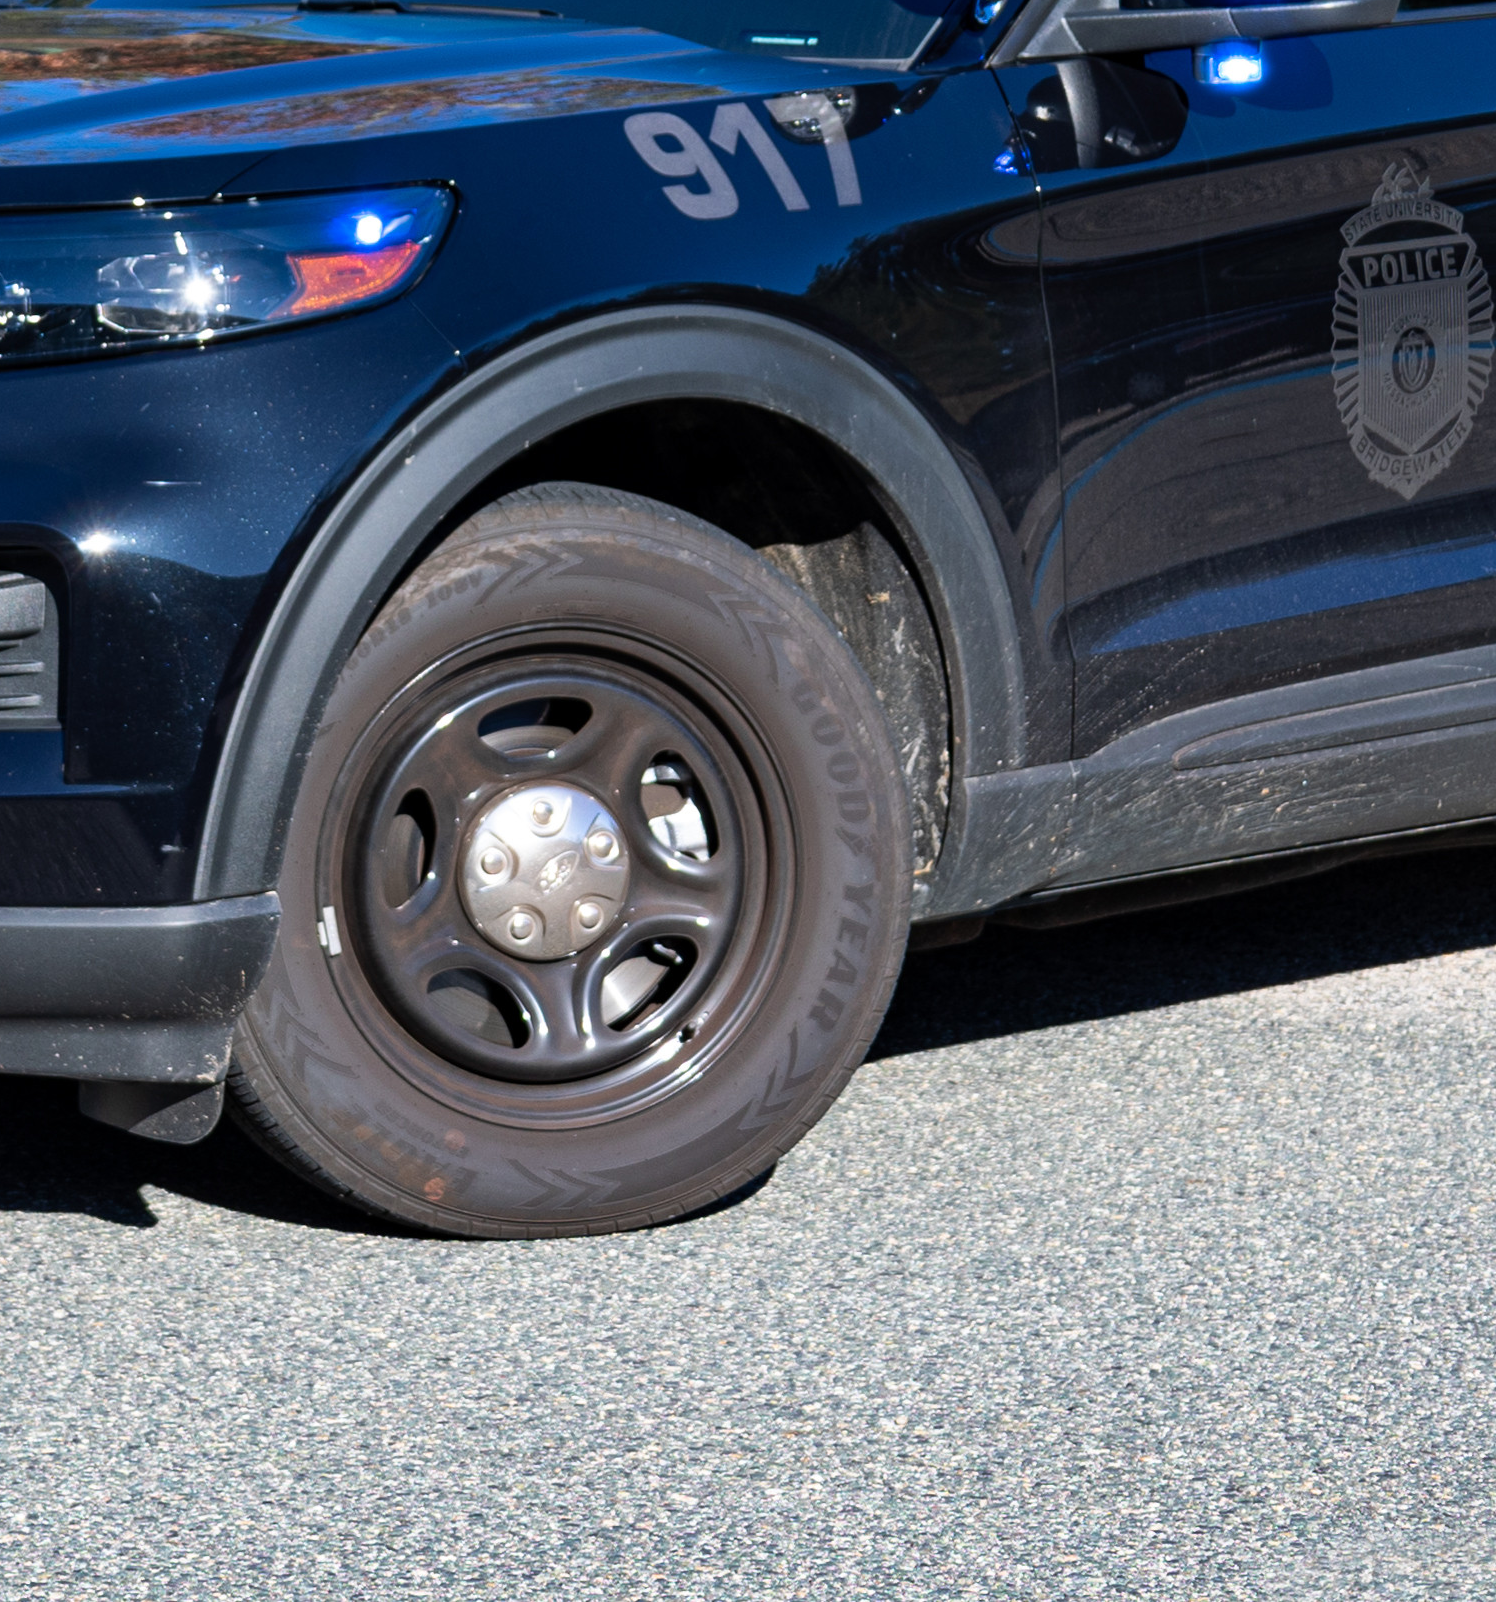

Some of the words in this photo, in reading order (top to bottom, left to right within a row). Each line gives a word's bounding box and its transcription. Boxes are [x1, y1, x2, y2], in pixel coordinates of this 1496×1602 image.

[623, 92, 863, 220] 917
[1344, 208, 1382, 242] STATE
[1384, 200, 1463, 228] UNIVERSITY
[1362, 246, 1458, 288] POLICE
[1356, 421, 1467, 477] BRIDGEWATER
